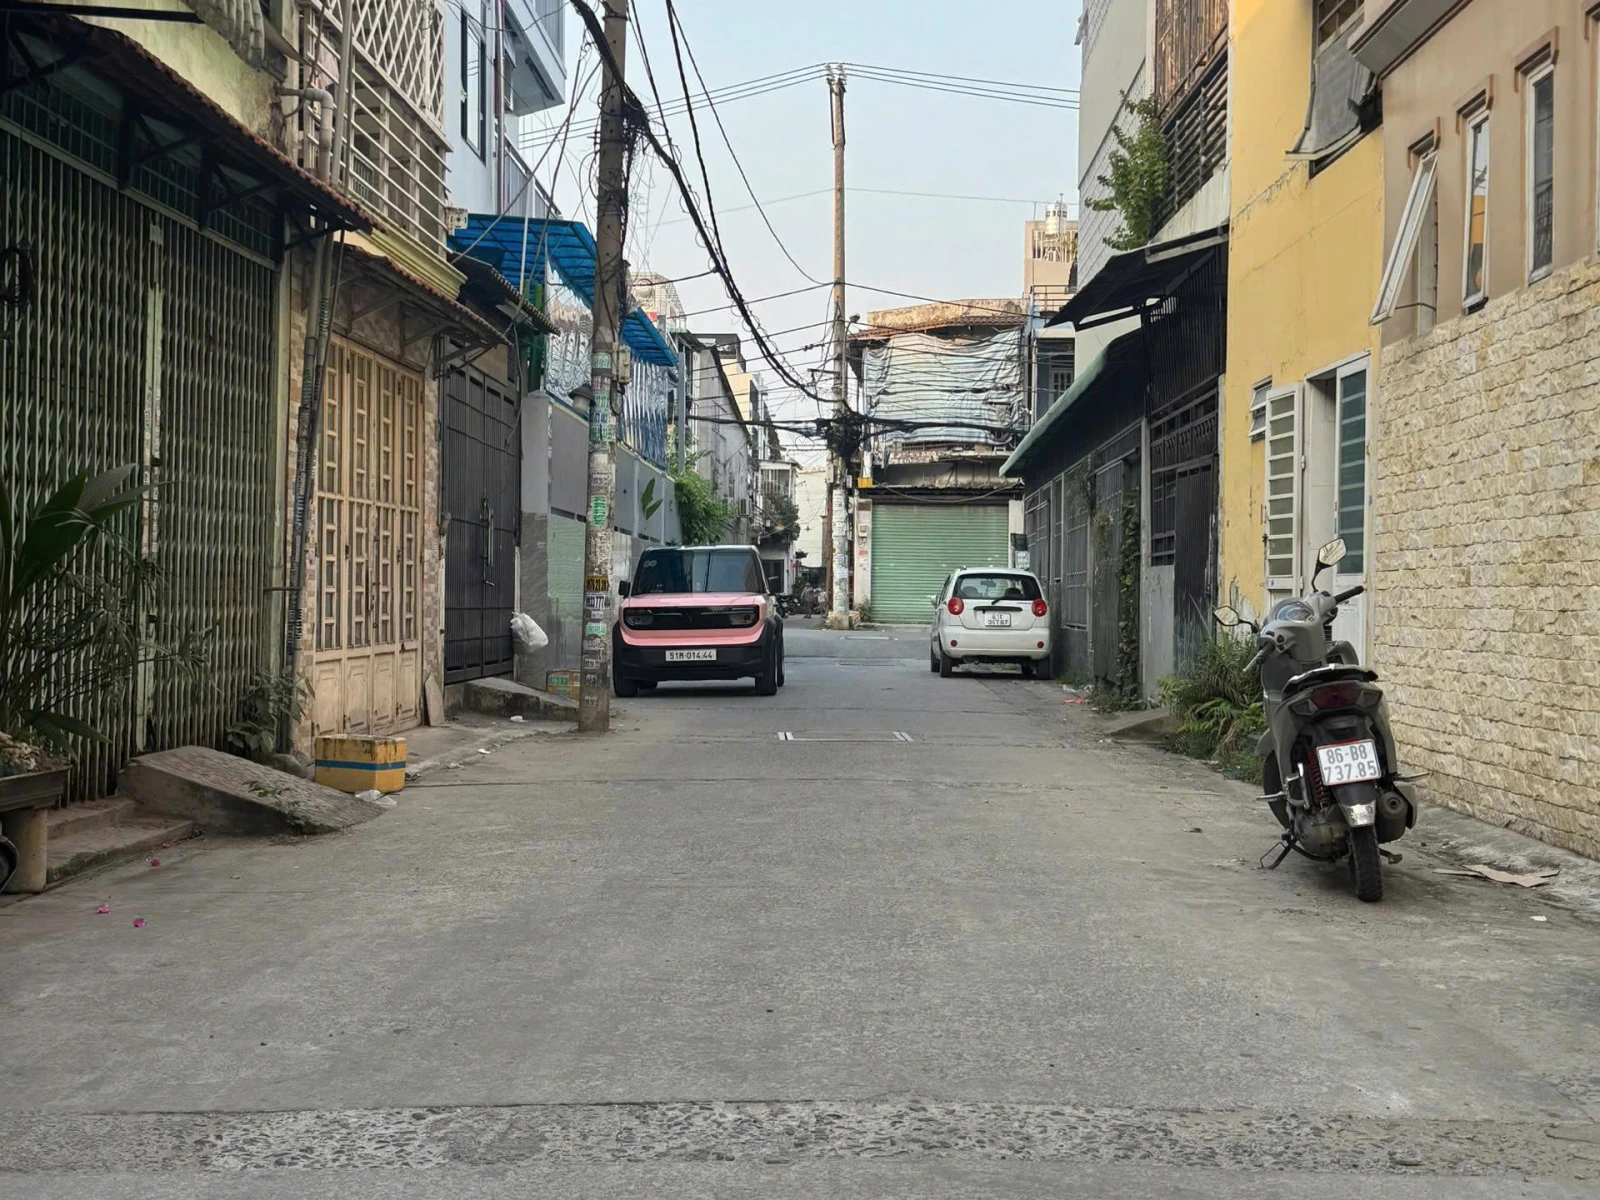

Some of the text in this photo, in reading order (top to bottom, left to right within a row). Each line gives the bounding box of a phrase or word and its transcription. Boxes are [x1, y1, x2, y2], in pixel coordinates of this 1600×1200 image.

[669, 651, 713, 660] 51M-014.44
[1326, 744, 1368, 765] 86-B8
[1324, 760, 1377, 784] 737.85
